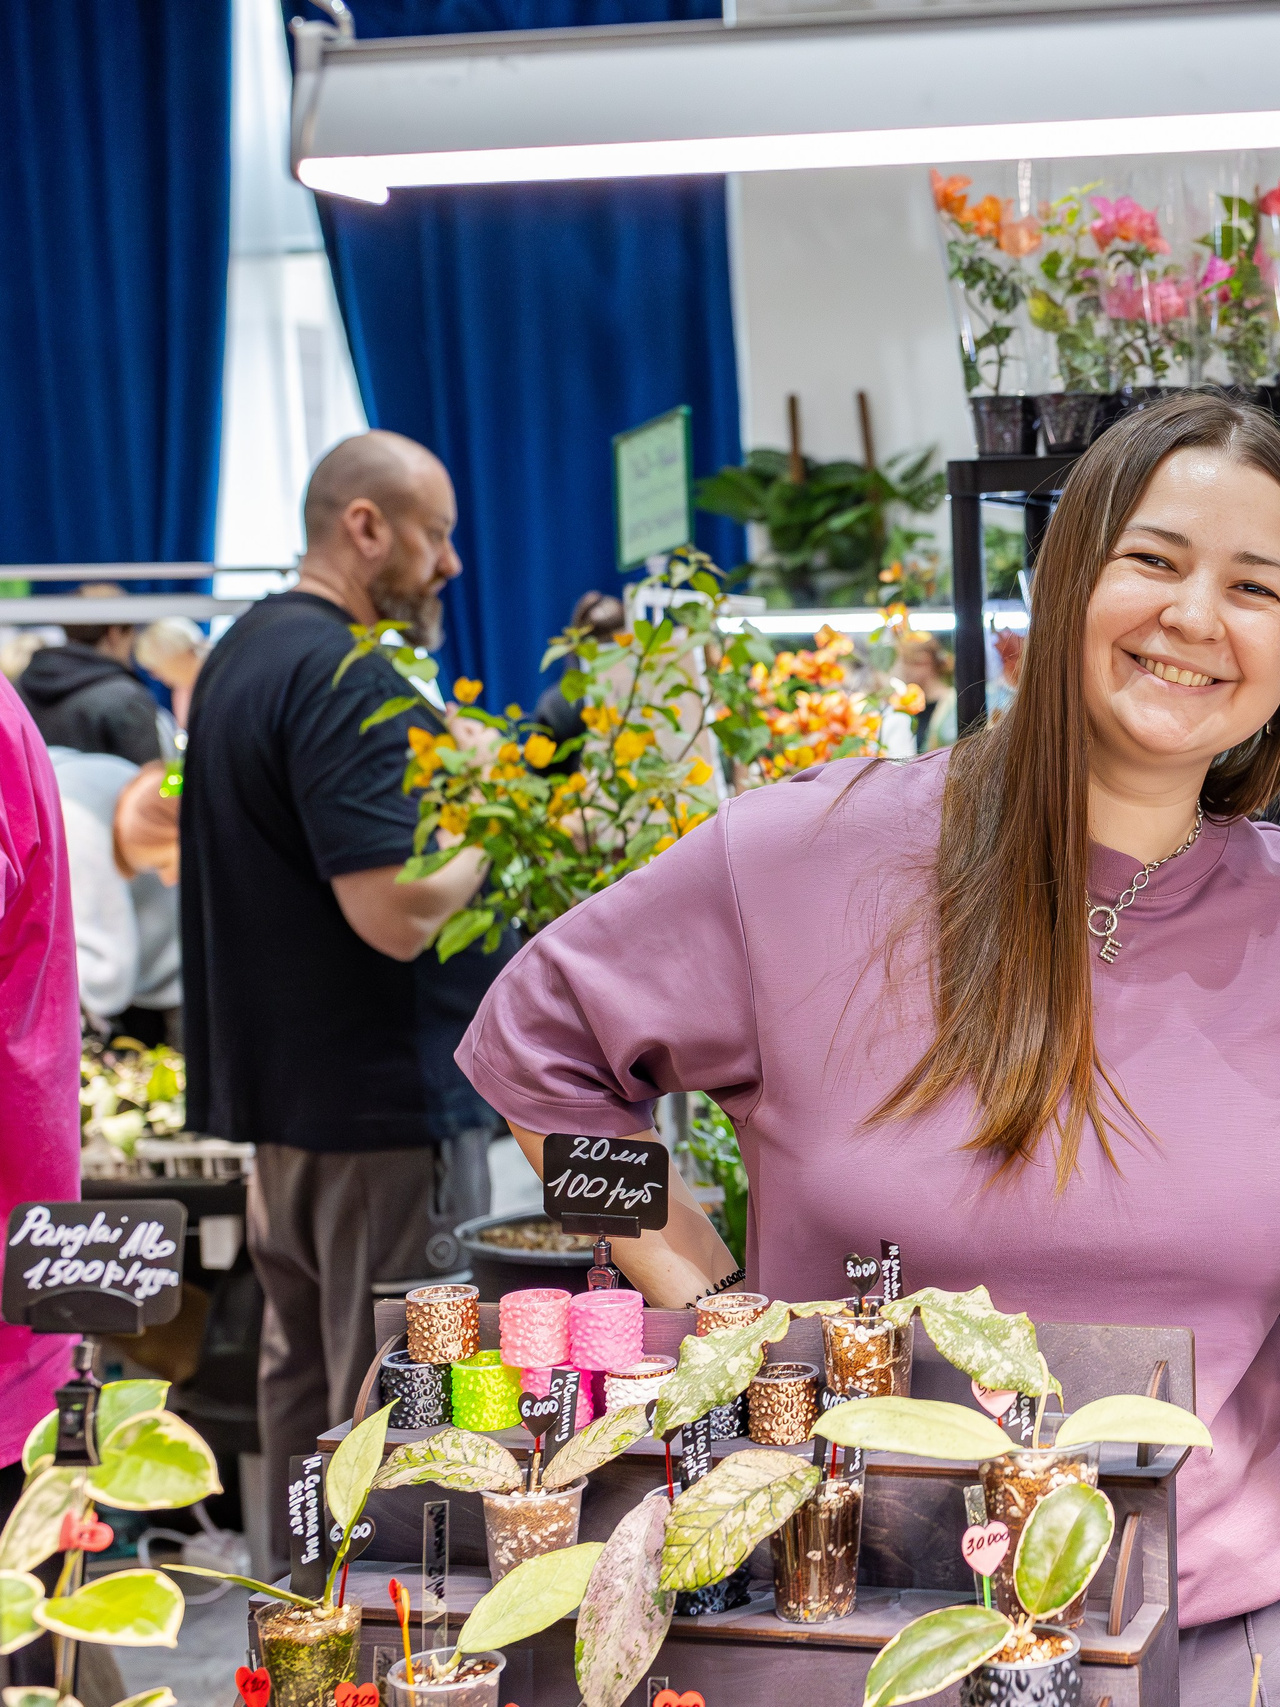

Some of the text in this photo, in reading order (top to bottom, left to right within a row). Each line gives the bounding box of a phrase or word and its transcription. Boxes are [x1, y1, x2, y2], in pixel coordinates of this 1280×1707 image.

[569, 1136, 611, 1161] 20
[547, 1168, 663, 1210] 100 руб
[846, 1260, 877, 1278] 5.000
[520, 1399, 560, 1418] 6.000
[288, 1480, 306, 1536] Silver
[329, 1522, 372, 1543] 6.00
